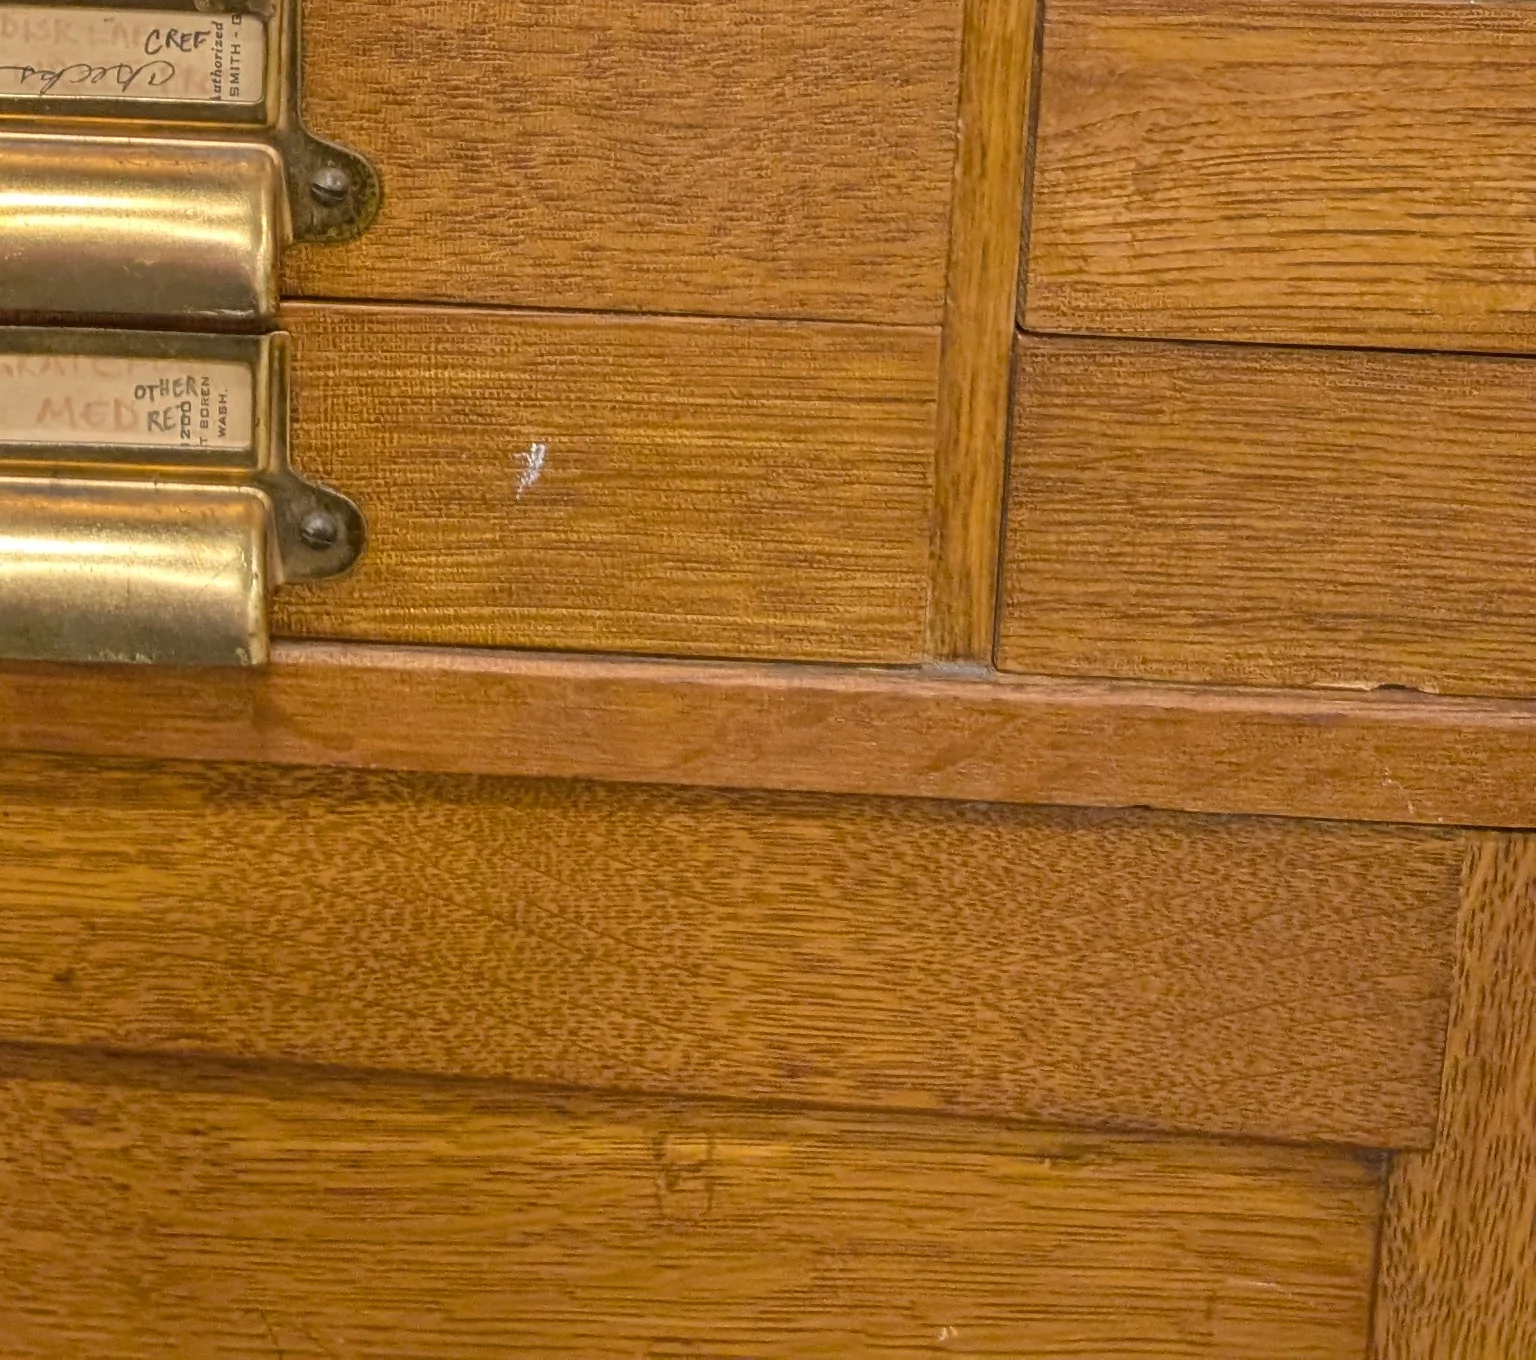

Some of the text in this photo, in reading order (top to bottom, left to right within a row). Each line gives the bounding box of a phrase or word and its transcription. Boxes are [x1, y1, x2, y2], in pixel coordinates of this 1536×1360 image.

[229, 44, 241, 97] SMITH
[133, 374, 199, 402] OTHER
[199, 377, 211, 429] BOREN
[218, 388, 229, 438] WASH.
